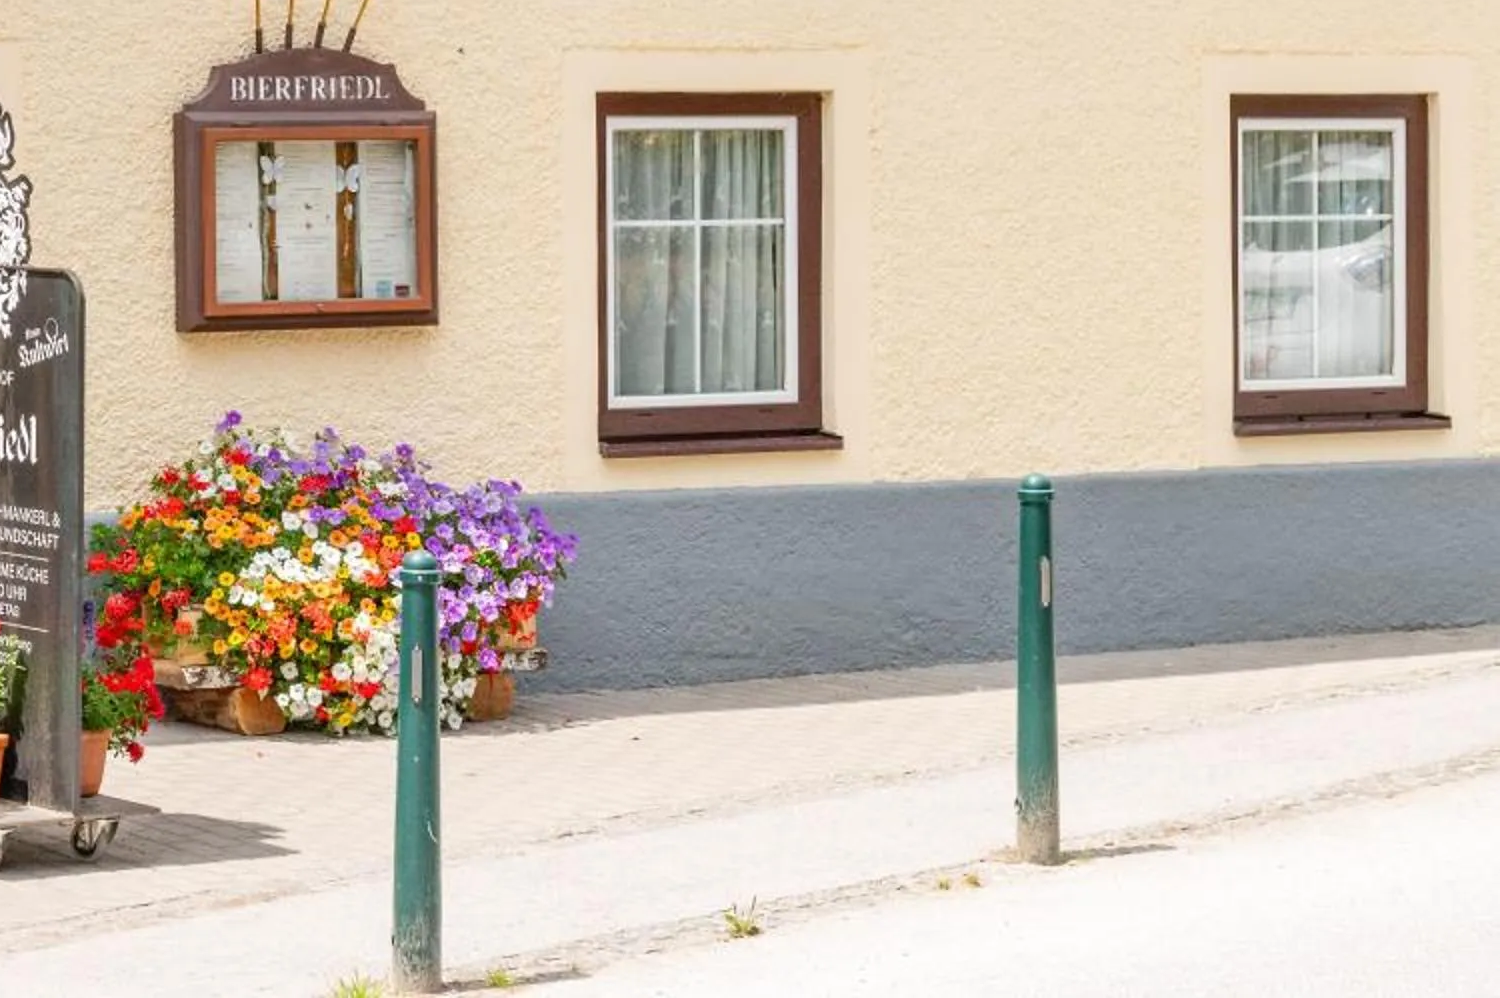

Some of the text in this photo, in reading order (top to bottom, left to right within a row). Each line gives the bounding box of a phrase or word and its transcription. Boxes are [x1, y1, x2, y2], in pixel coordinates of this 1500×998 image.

[230, 75, 391, 101] BIERFRIEDL
[16, 563, 49, 585] KÜCHE
[6, 585, 28, 602] UHR
